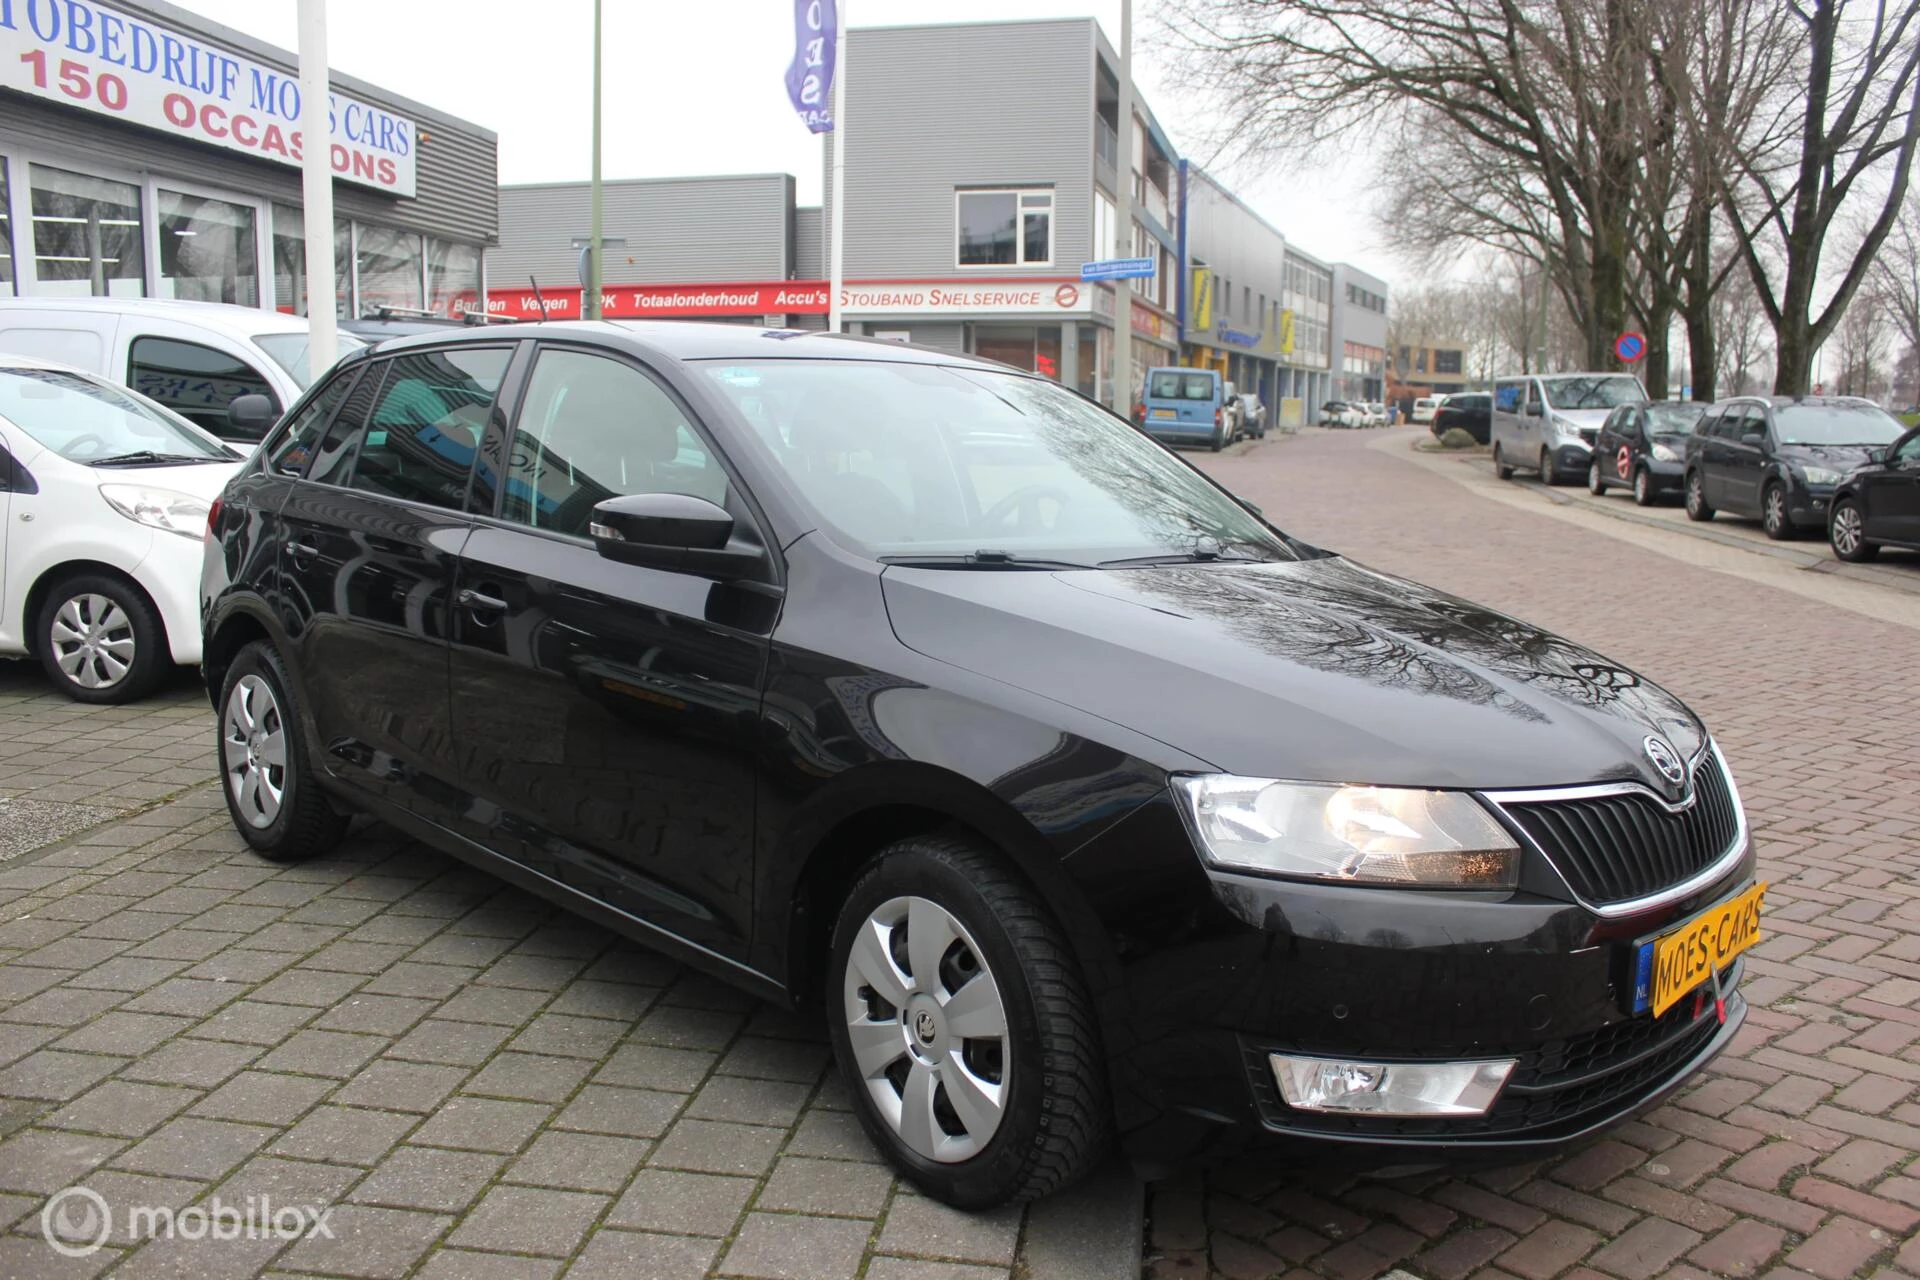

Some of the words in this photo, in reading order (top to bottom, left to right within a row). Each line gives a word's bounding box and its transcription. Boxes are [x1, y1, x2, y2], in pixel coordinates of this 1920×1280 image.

[20, 49, 128, 111] 150
[163, 93, 397, 185] OCCASONS
[250, 68, 336, 134] MOS
[344, 103, 409, 157] CARS
[633, 291, 759, 308] Totaalonderhoud
[774, 290, 828, 305] Accu's
[1635, 983, 1648, 1001] NL
